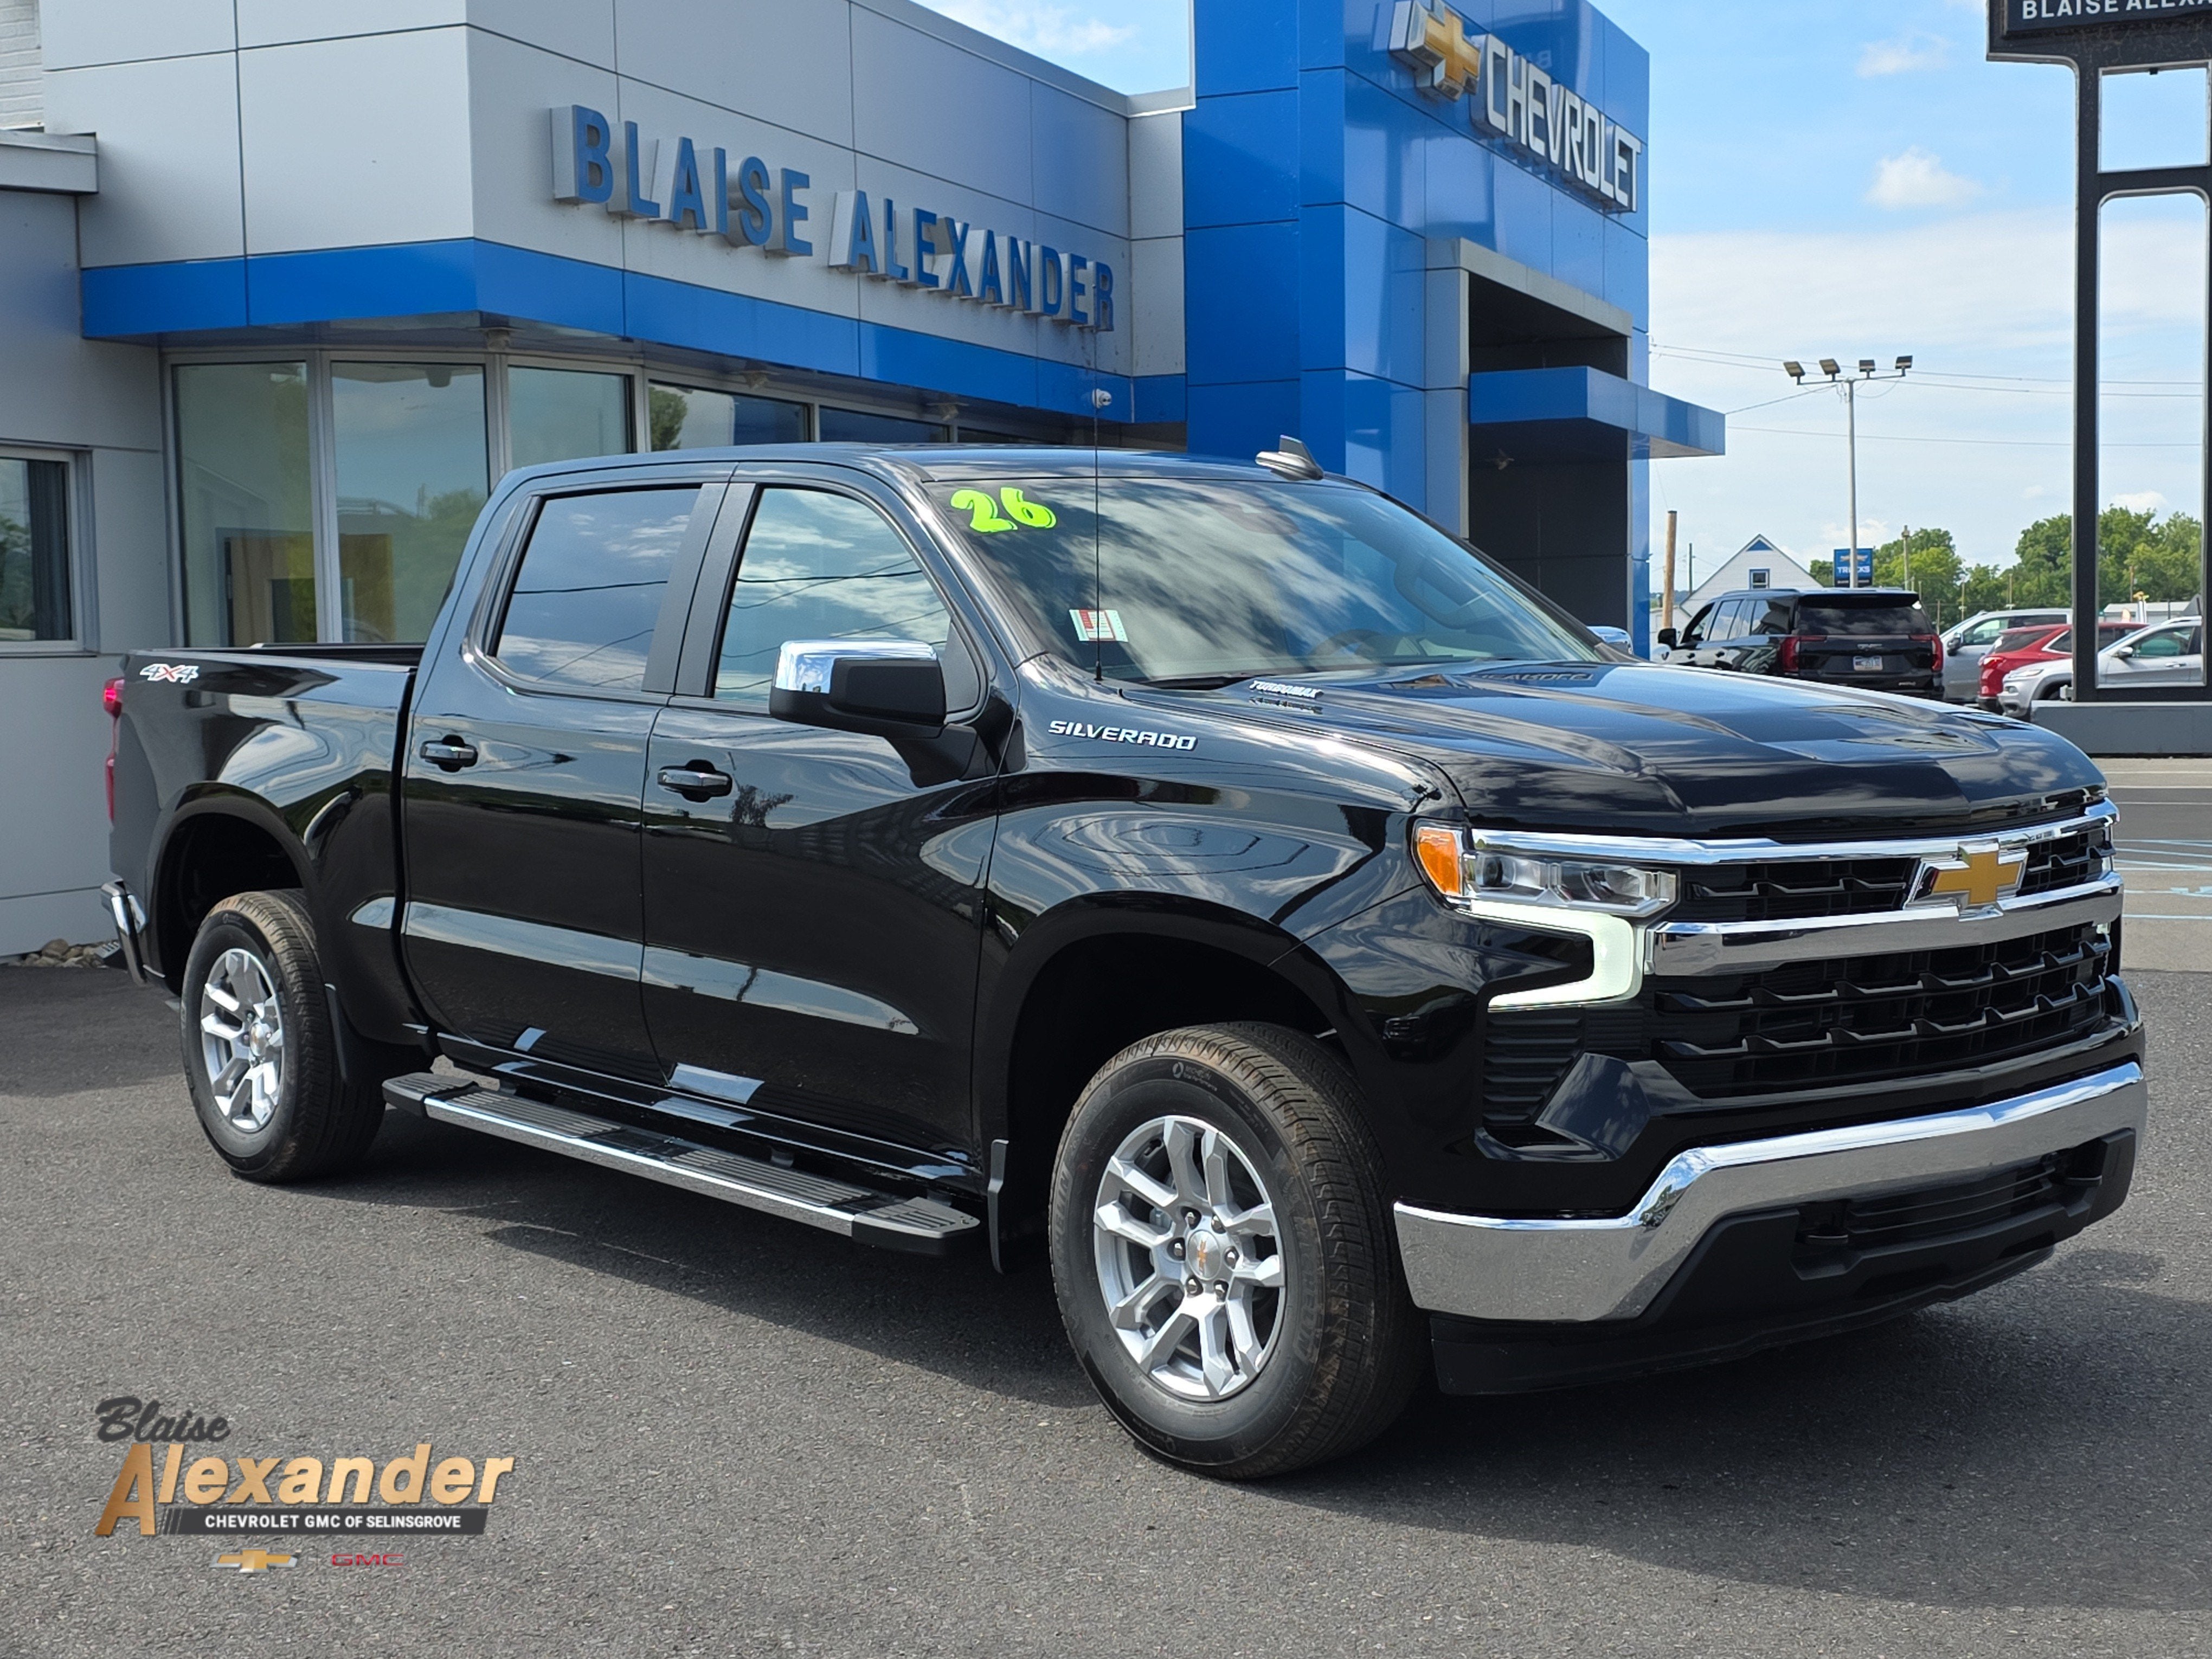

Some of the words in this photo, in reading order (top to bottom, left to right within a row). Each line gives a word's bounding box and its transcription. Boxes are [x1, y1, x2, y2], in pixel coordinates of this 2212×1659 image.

[2022, 0, 2118, 20] BLAISE
[1484, 33, 1642, 213] CHEVROLET
[572, 104, 813, 257] BLAISE
[847, 189, 1114, 332] ALEXANDER
[950, 487, 1057, 532] 26
[1047, 720, 1198, 751] SILVERADO
